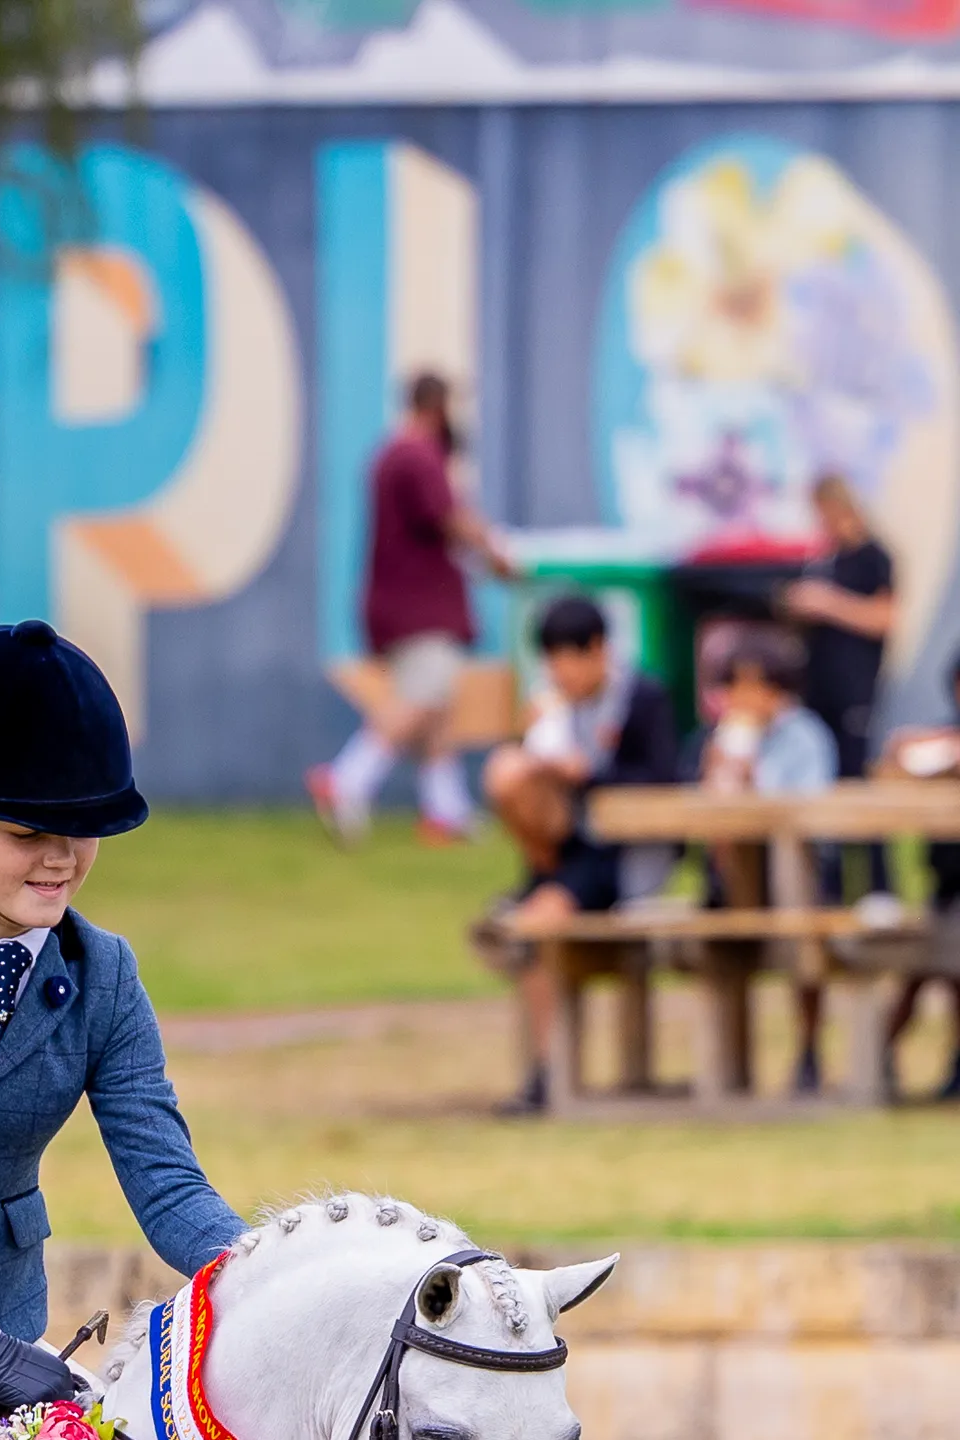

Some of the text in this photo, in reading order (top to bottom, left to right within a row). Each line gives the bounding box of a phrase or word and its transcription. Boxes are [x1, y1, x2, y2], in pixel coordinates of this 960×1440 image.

[160, 1299, 173, 1392] ULTURAL
[191, 1308, 221, 1440] ROYAL SHOW
[176, 1401, 192, 1439] 12.2
